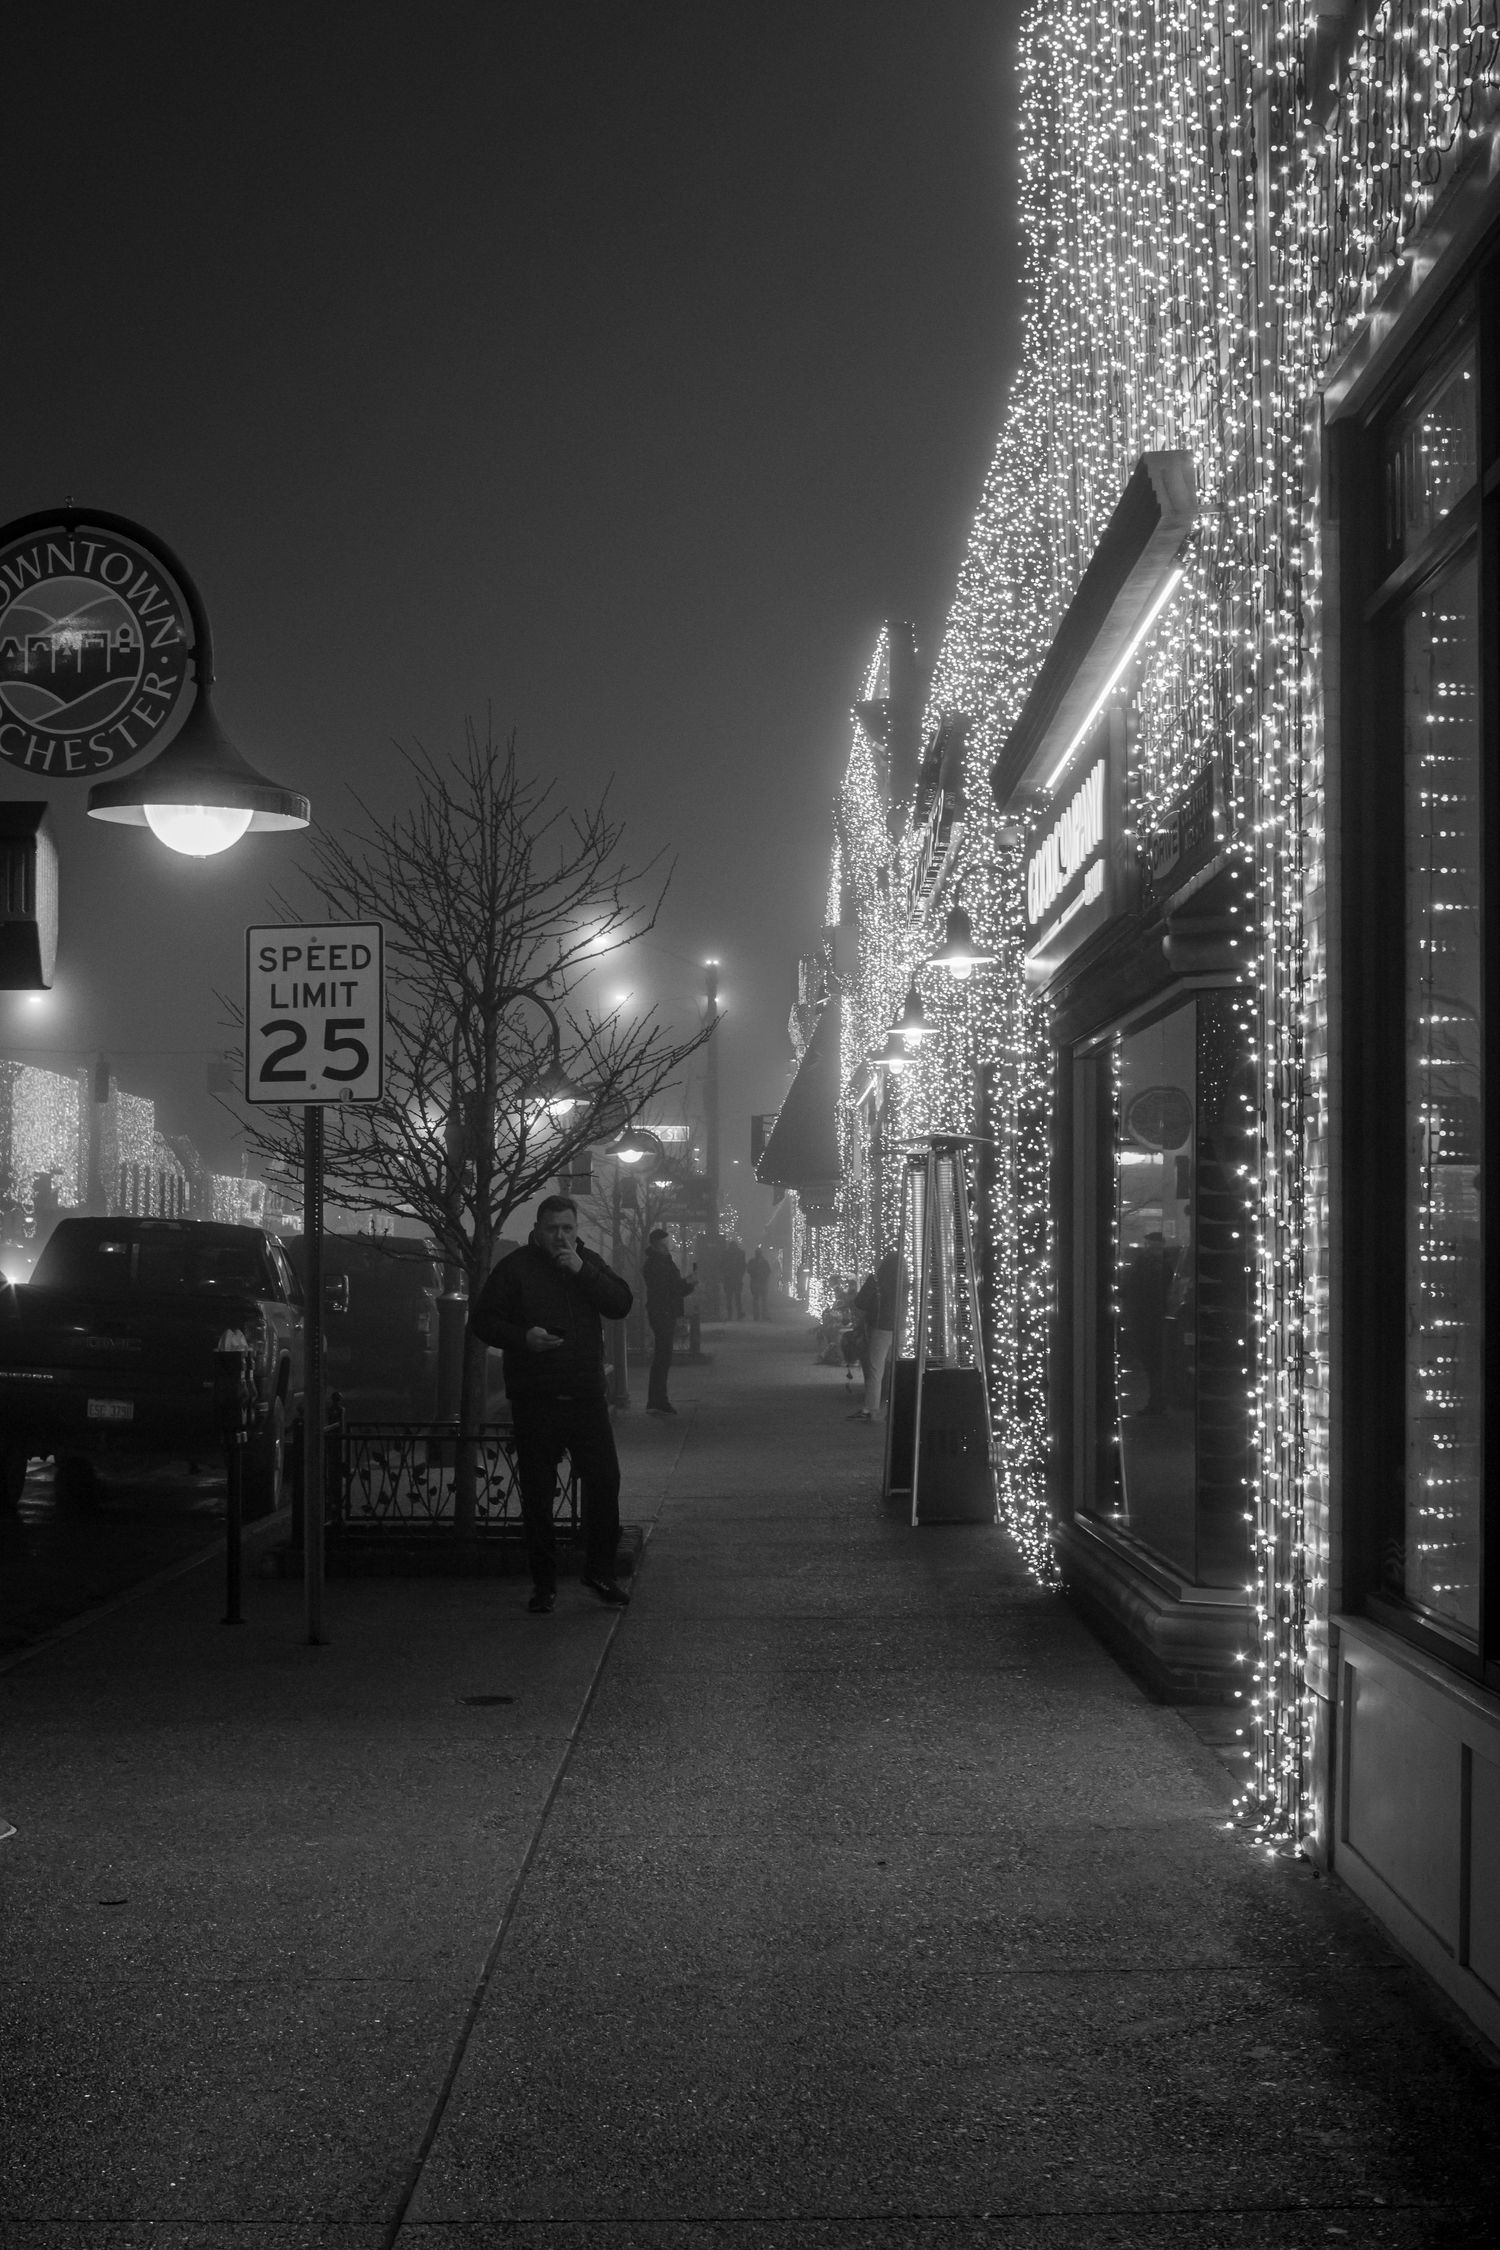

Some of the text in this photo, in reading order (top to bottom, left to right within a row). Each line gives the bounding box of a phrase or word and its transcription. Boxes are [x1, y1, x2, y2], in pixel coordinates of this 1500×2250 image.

[0, 671, 178, 772] CHESTER
[258, 944, 372, 973] SPEED
[270, 981, 358, 1009] LIMIT
[259, 1018, 370, 1082] 25
